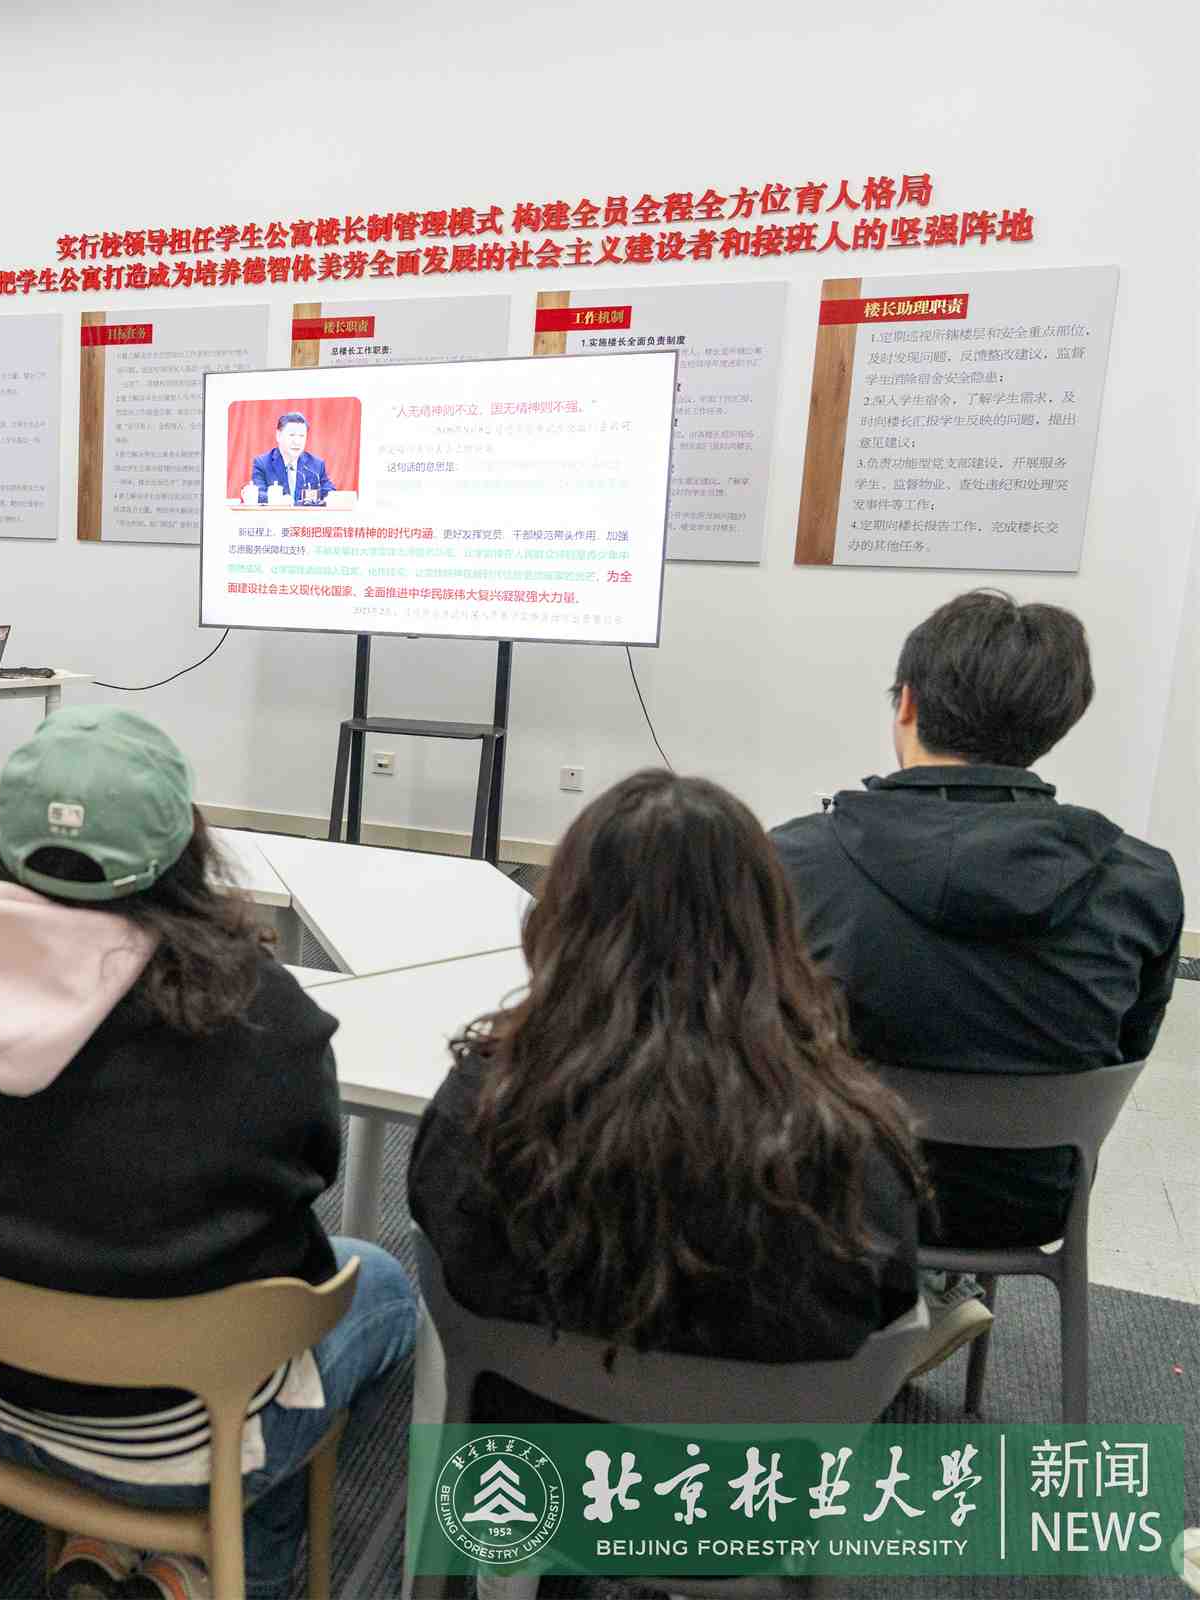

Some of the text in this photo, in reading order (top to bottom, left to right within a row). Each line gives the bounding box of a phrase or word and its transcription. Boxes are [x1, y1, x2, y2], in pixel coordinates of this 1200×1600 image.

[57, 173, 933, 261] 实行校领导担任学生公寓楼长制管理模式 构建全员全程全方位育人格局
[864, 298, 963, 317] 楼长助理职责
